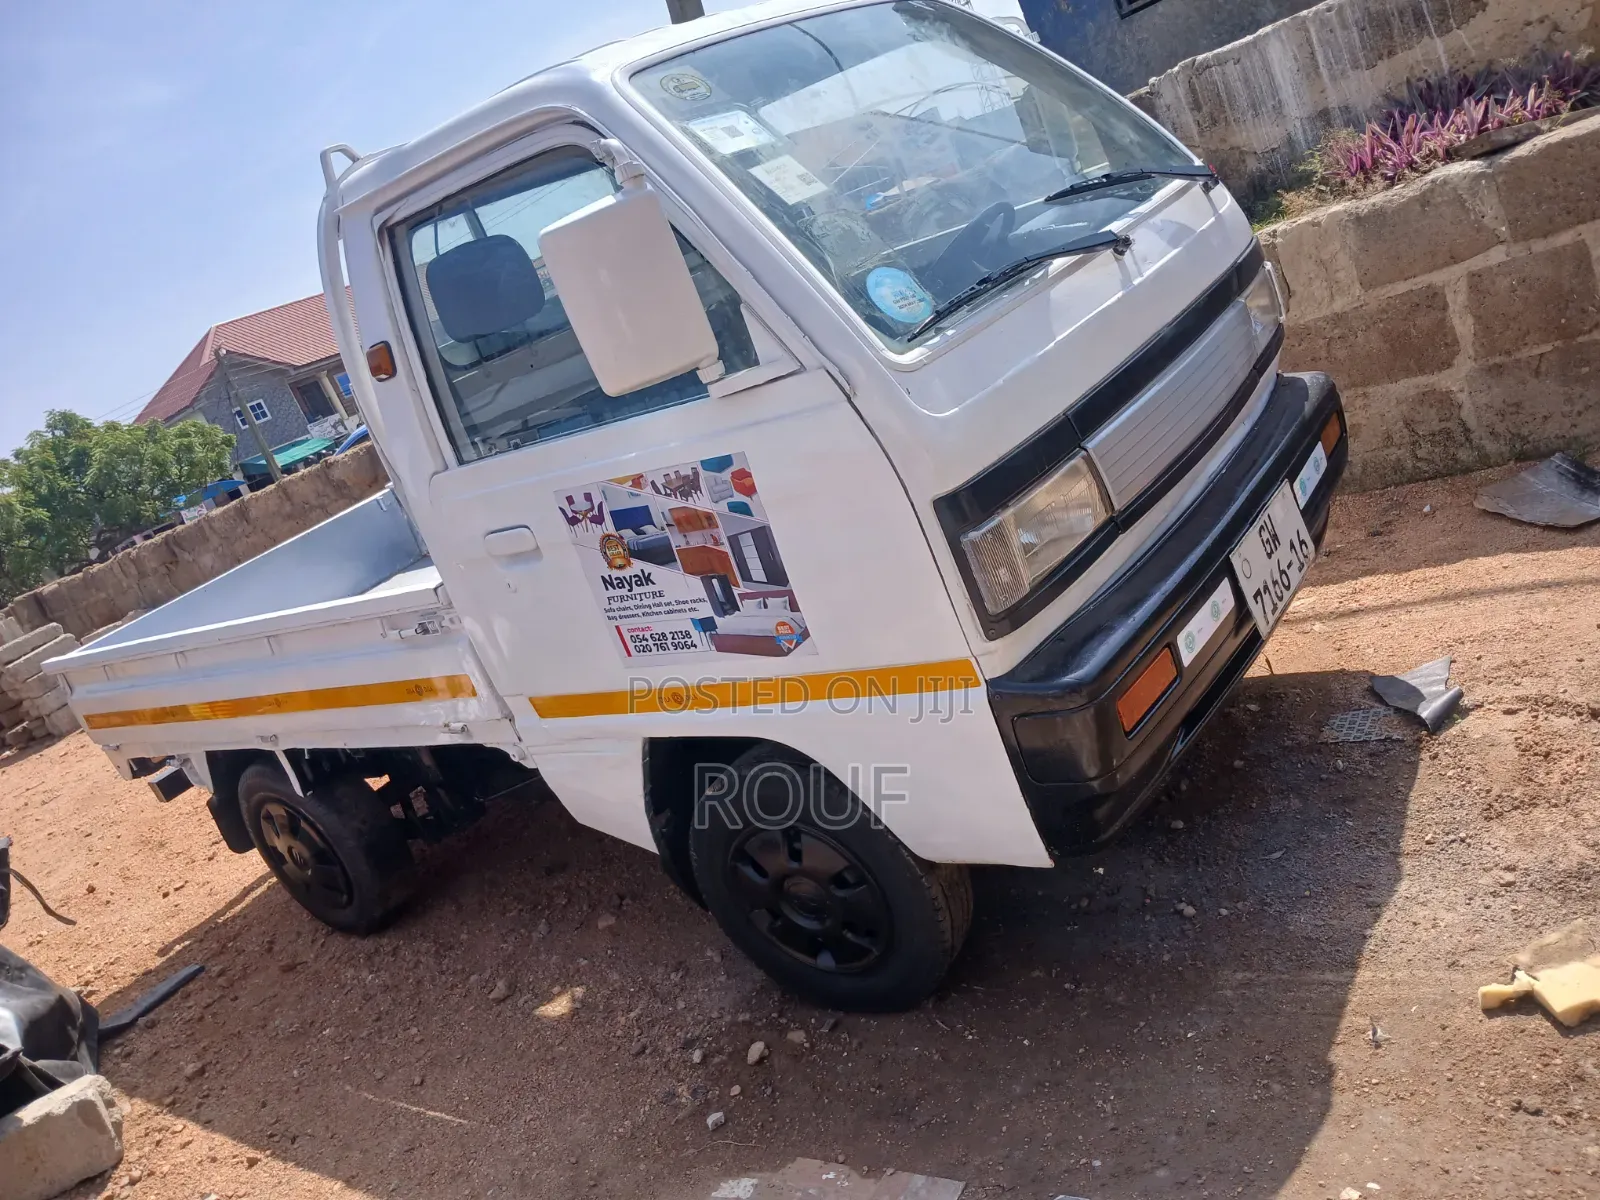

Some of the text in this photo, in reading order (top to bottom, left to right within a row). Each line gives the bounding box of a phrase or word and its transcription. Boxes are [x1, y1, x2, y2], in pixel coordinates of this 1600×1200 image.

[1258, 513, 1281, 560] GW
[600, 569, 656, 592] Nayak
[1252, 529, 1309, 626] 7166-16
[607, 590, 665, 605] FURNITURE
[634, 602, 652, 611] Dining
[642, 610, 663, 618] Kitchen
[627, 625, 653, 634] contact:
[630, 630, 692, 644] 054 628 2138
[634, 640, 698, 653] 020 761 9064
